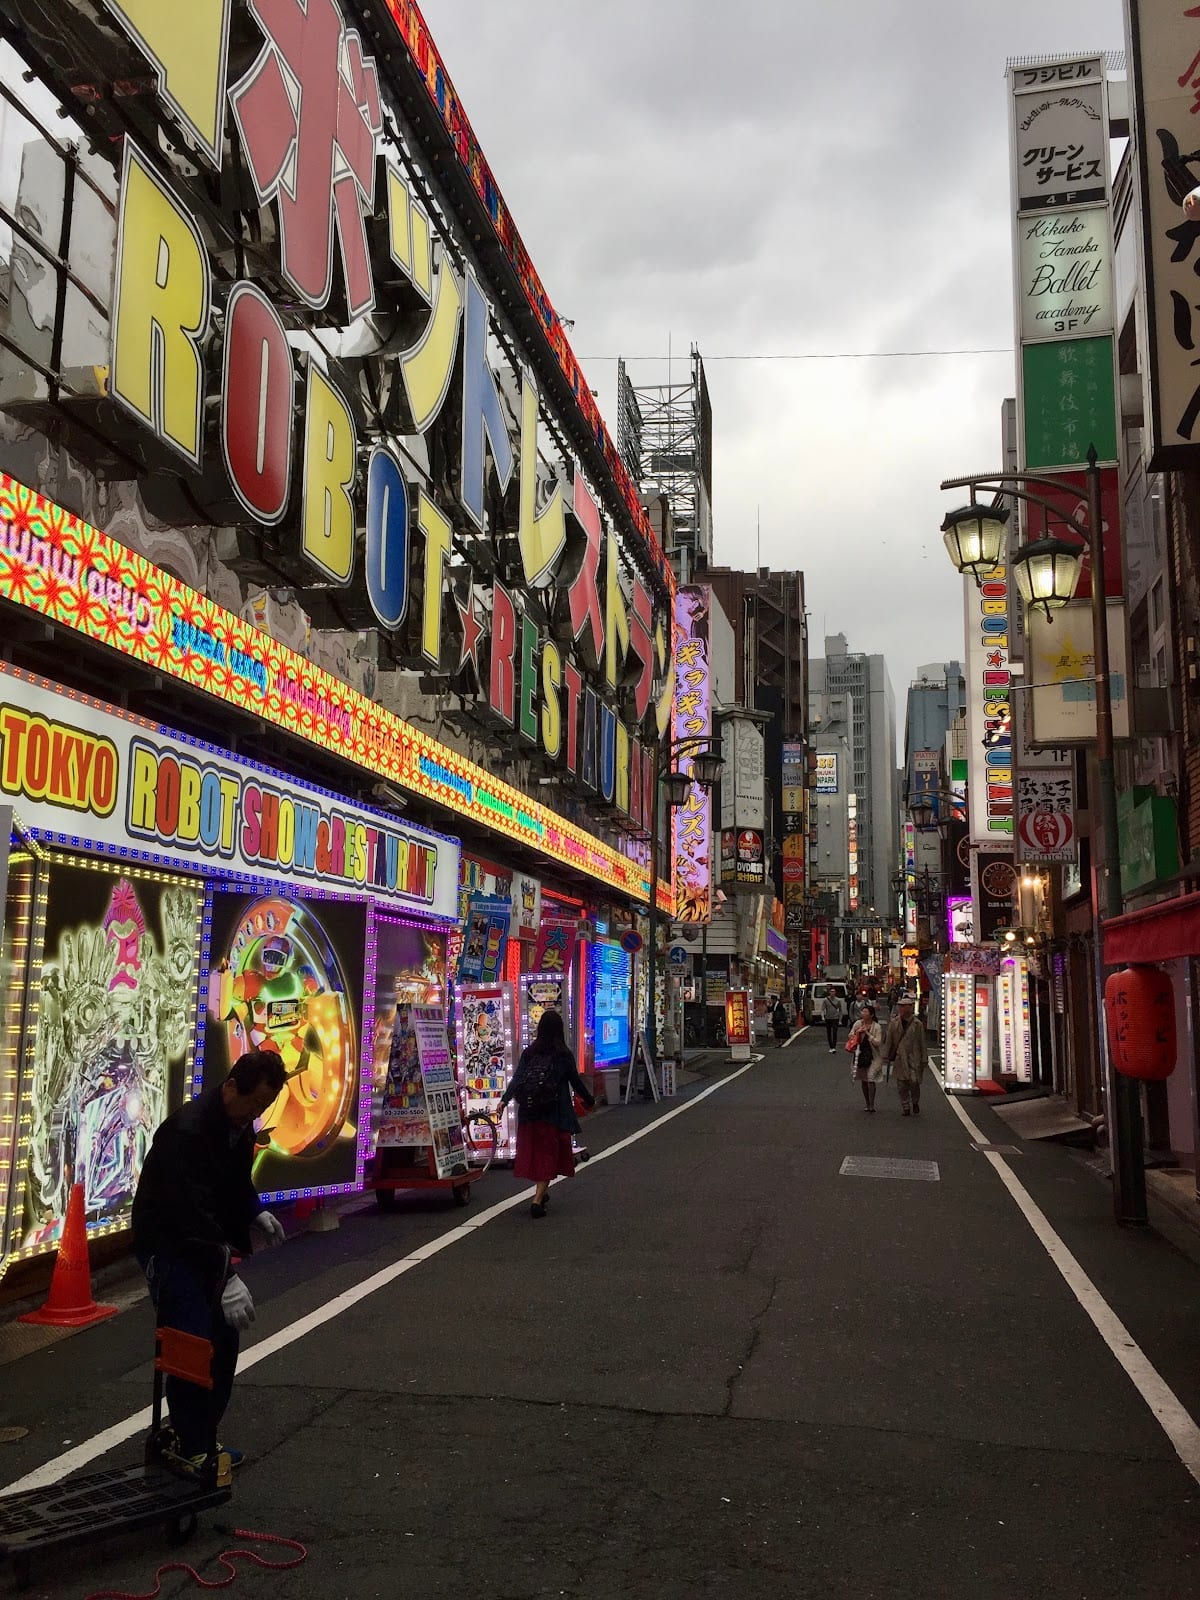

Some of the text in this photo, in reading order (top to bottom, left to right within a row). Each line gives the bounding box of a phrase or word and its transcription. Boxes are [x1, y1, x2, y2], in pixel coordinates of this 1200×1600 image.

[1024, 66, 1091, 85] フジビル
[1023, 144, 1084, 167] クリーン
[1036, 158, 1102, 185] サービス
[1028, 258, 1102, 296] Ballet
[1035, 300, 1102, 325] academy
[1054, 319, 1078, 332] 3F
[110, 133, 453, 669] ROBOT
[1051, 749, 1068, 762] 1F
[2, 706, 116, 812] TOKYO
[132, 747, 240, 854] ROBOT
